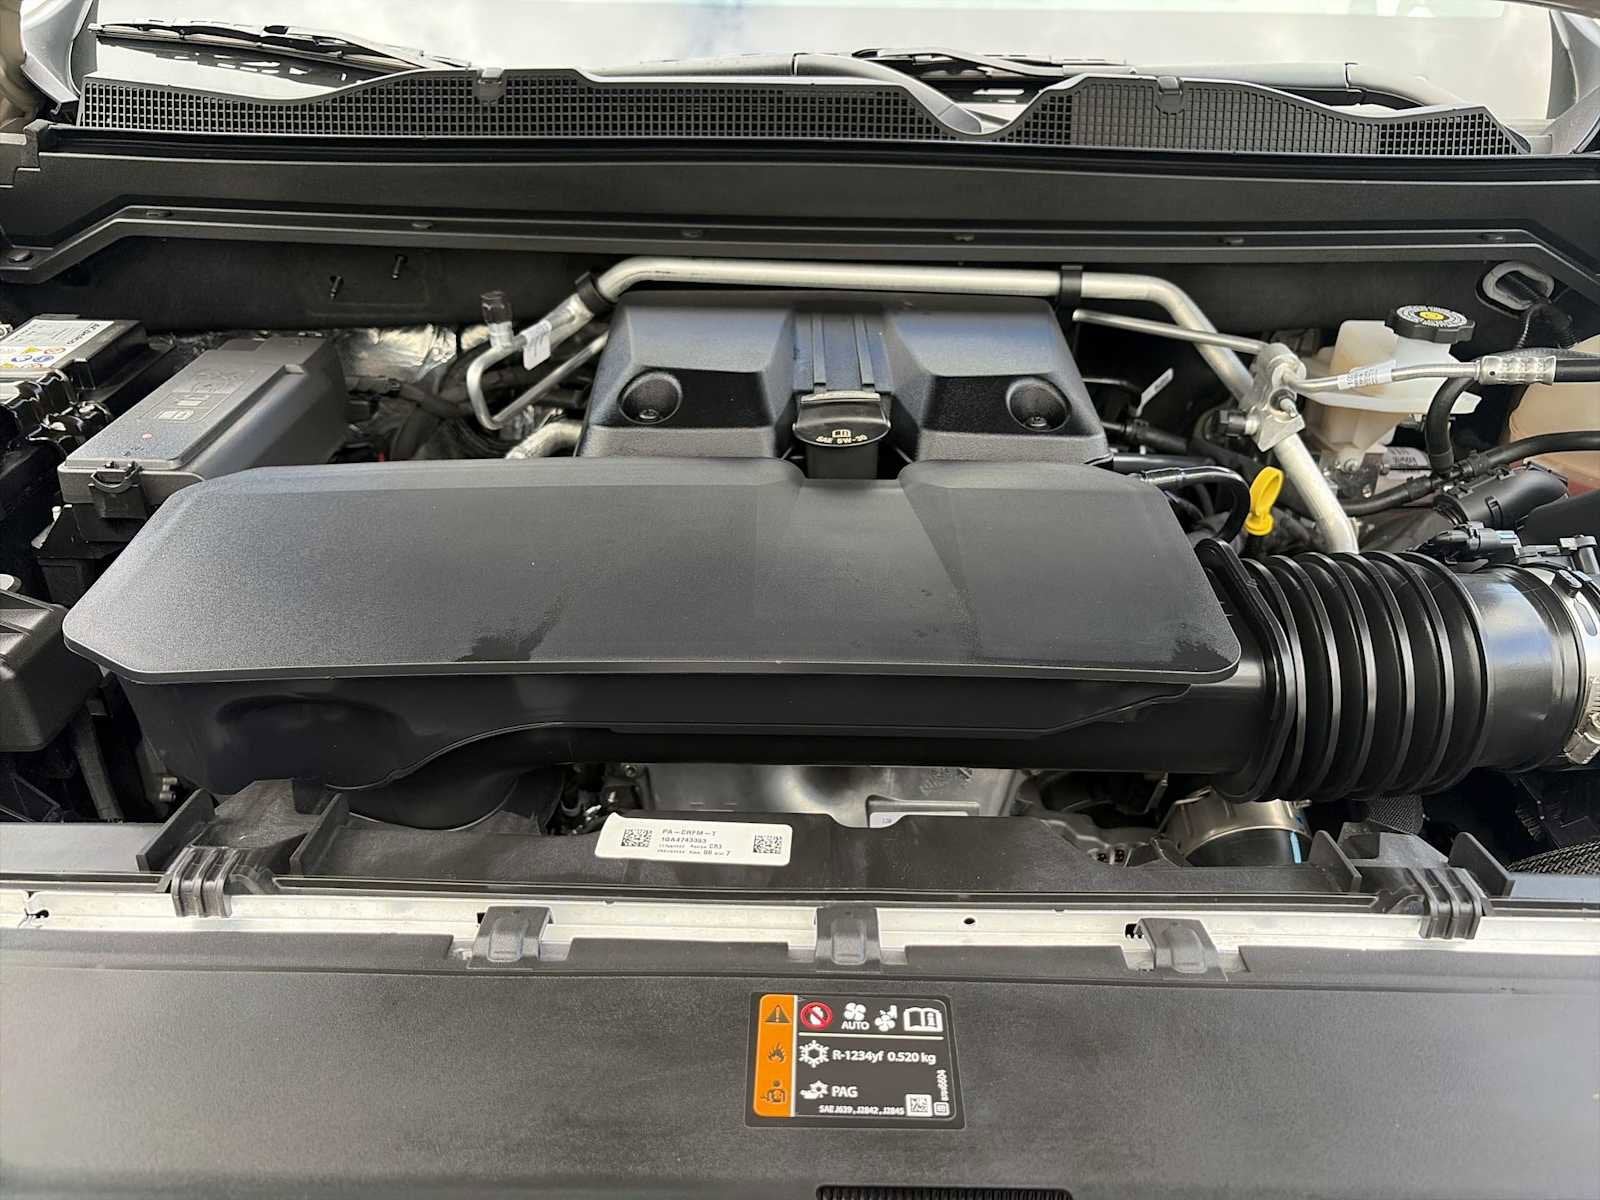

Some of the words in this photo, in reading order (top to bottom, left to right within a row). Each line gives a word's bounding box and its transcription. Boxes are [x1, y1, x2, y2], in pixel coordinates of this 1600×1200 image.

[841, 1021, 870, 1031] AUTO
[832, 1049, 884, 1063] R-1234yf
[887, 1051, 920, 1063] 0.520
[920, 1052, 937, 1065] kg
[831, 1086, 859, 1098] PAG
[818, 1104, 834, 1113] SAE
